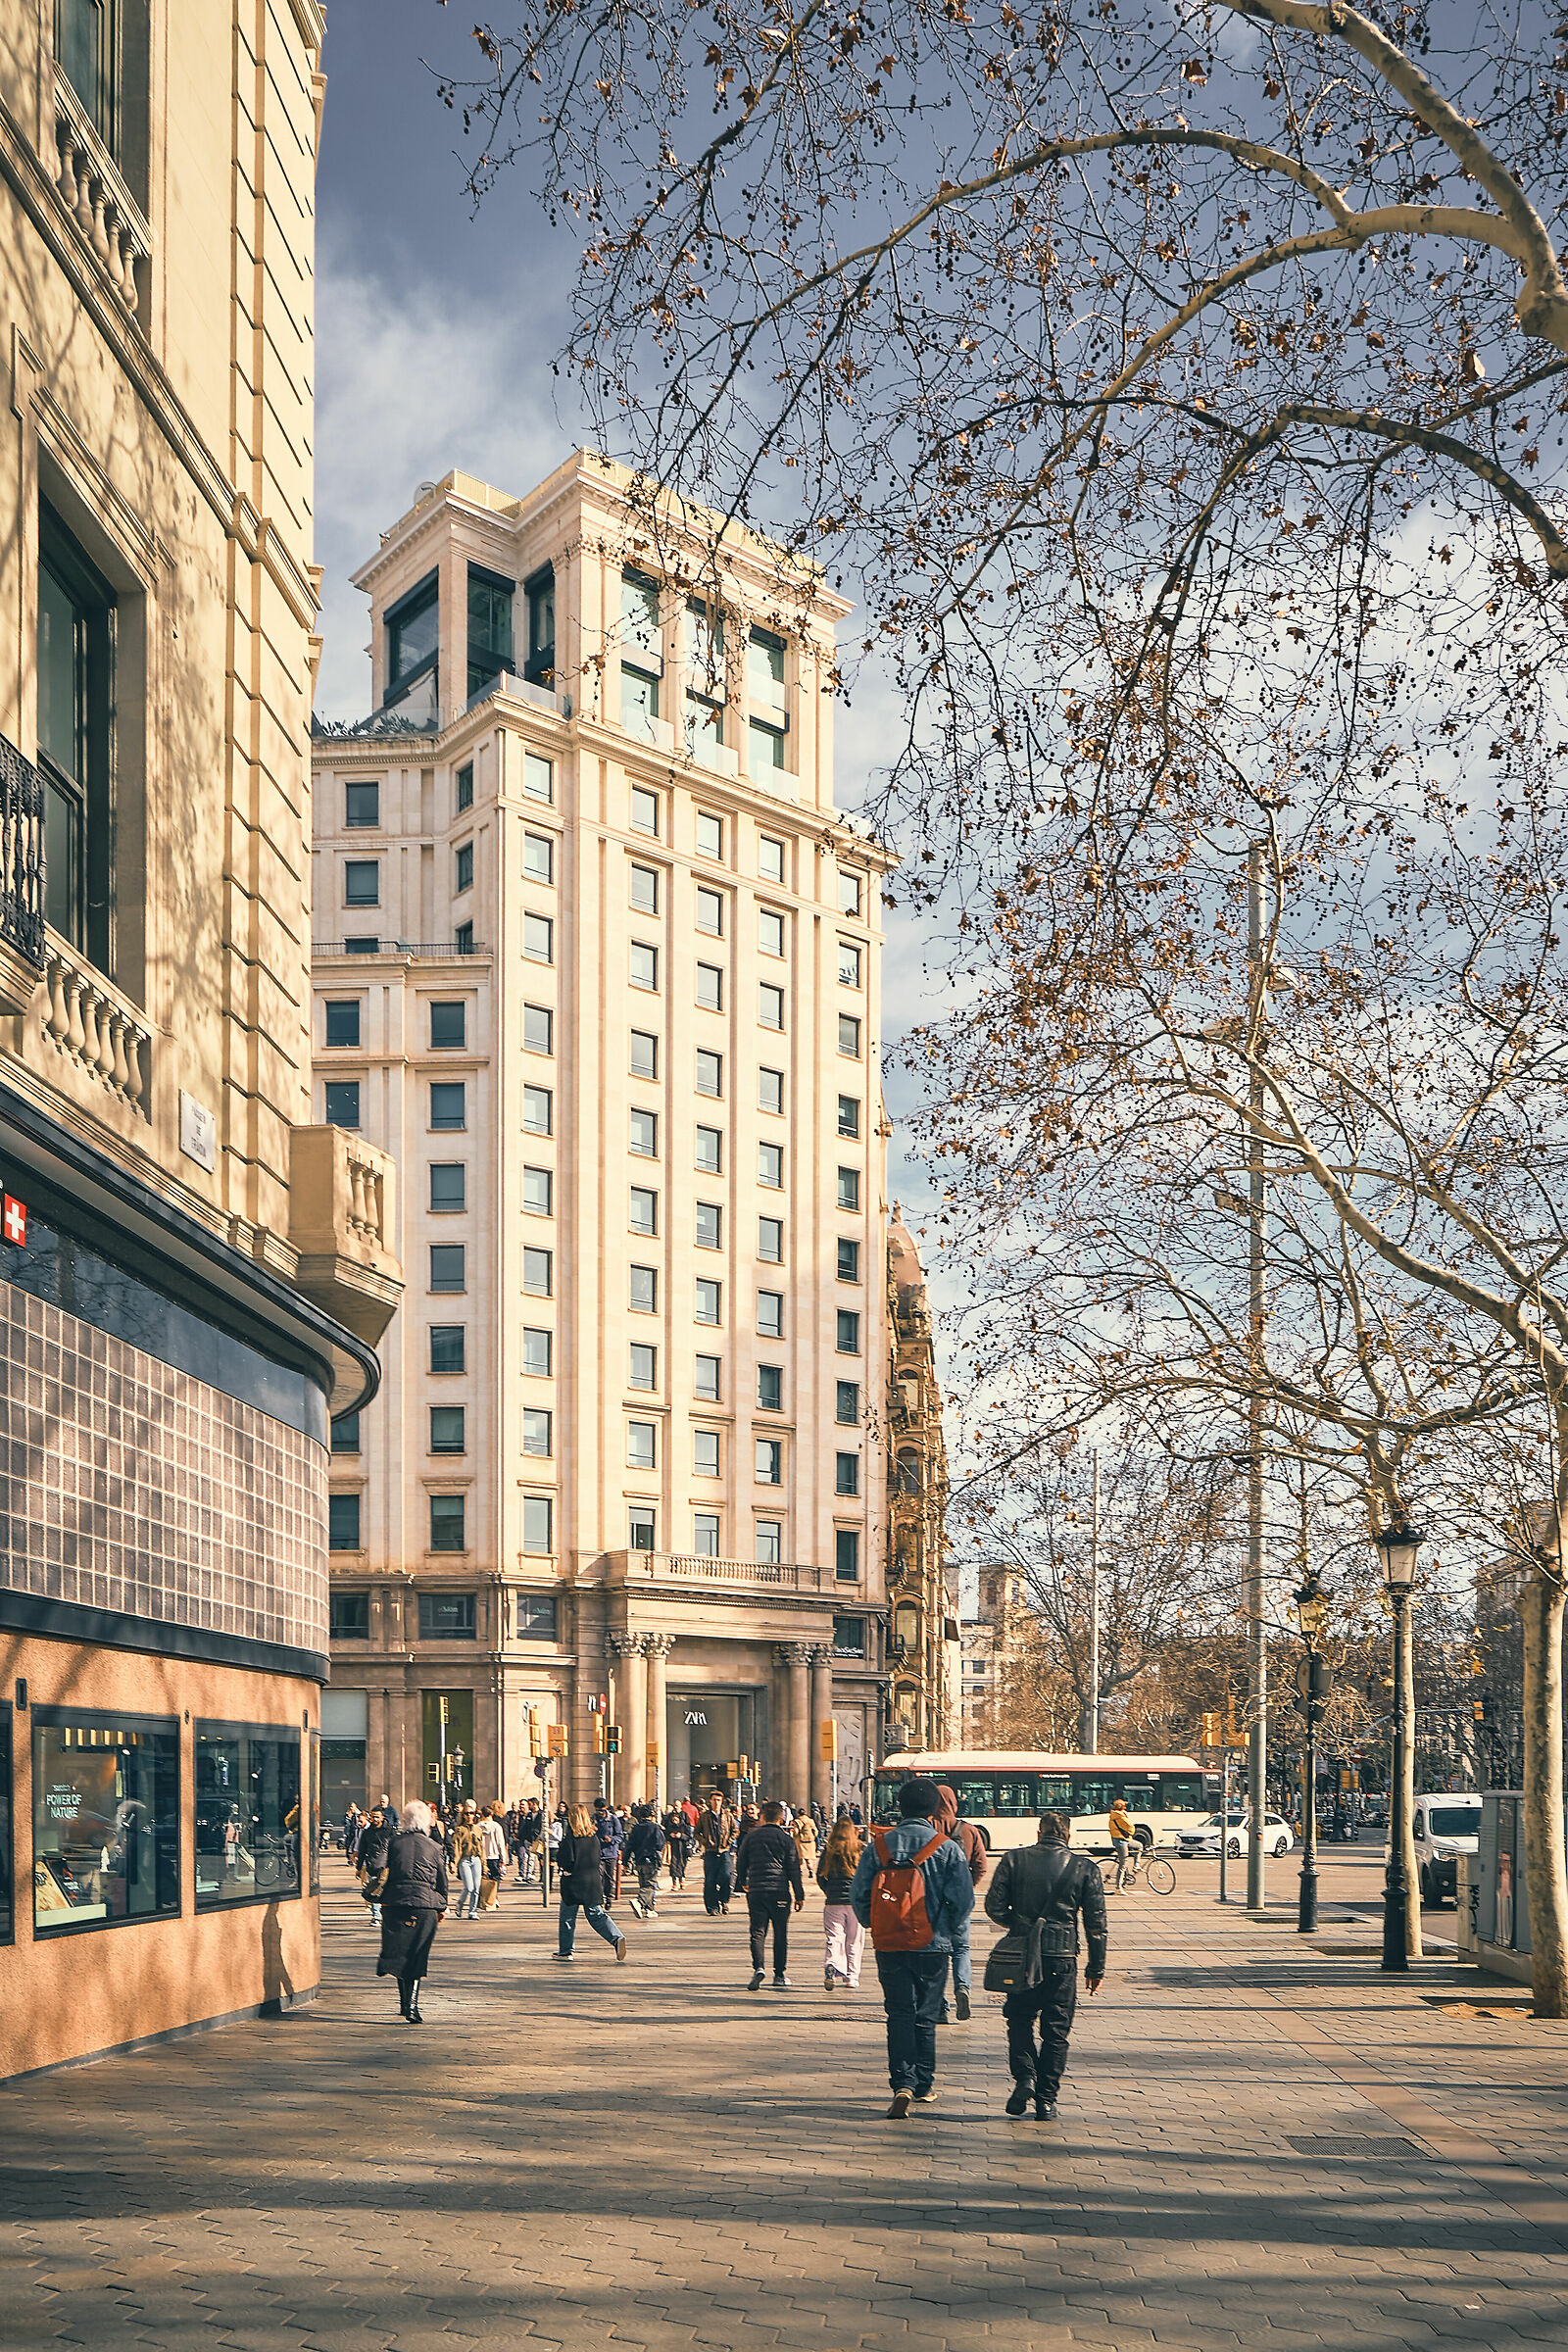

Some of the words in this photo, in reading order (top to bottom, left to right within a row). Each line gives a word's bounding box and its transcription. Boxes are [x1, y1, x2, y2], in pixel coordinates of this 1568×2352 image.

[684, 1710, 708, 1725] ZARA
[46, 1793, 72, 1805] POWER
[72, 1793, 82, 1805] OF
[50, 1806, 78, 1820] NATURE
